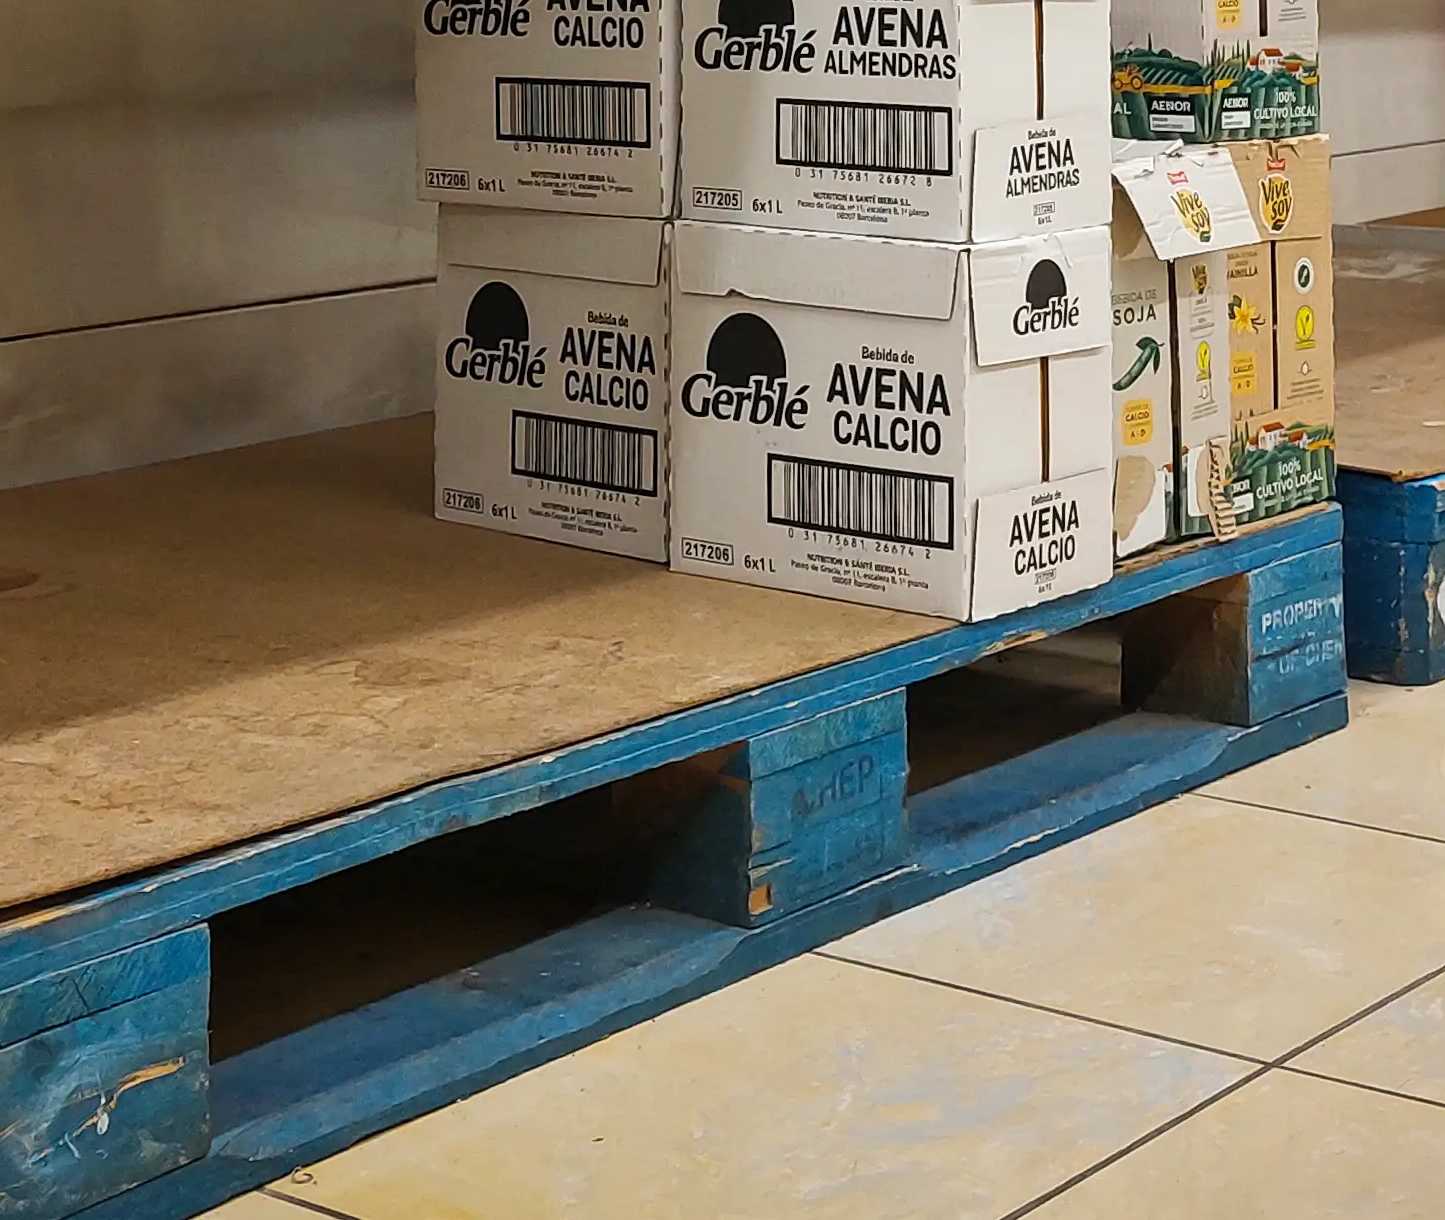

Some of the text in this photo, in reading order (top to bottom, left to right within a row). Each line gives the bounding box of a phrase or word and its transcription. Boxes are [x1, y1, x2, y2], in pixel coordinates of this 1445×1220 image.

[554, 16, 644, 49] CALCIO
[832, 6, 949, 50] AVENA
[694, 25, 817, 73] Gerblé
[823, 49, 956, 80] ALMENDRAS
[1254, 104, 1317, 118] CULTIVO LOCAL
[1274, 91, 1296, 104] 100%
[1009, 138, 1075, 176] AVENA
[428, 171, 466, 187] 217206
[1005, 168, 1081, 199] ALMENDRAS
[1262, 178, 1291, 203] Vive
[695, 189, 739, 207] 217205
[1171, 191, 1202, 218] Vive
[1271, 197, 1293, 221] soy
[1192, 204, 1212, 230] soy
[588, 311, 629, 327] Bebida de
[1012, 296, 1080, 336] Gerblé
[1113, 305, 1157, 326] SOJA
[445, 336, 548, 389] Gerblé
[559, 327, 656, 376] AVENA
[861, 345, 915, 365] Bebida de
[564, 369, 649, 412] CALCIO
[681, 371, 810, 429] Gerblé
[826, 362, 951, 417] AVENA
[833, 408, 942, 457] CALCIO
[1125, 412, 1149, 423] CALCIO
[1278, 458, 1301, 477] 100%
[1256, 477, 1293, 499] CULTIVO
[1294, 469, 1324, 488] LOCAL
[1009, 499, 1080, 547] AVENA
[684, 541, 730, 562] 217206
[1014, 534, 1076, 576] CALCIO
[1262, 593, 1342, 634] PROPERTY
